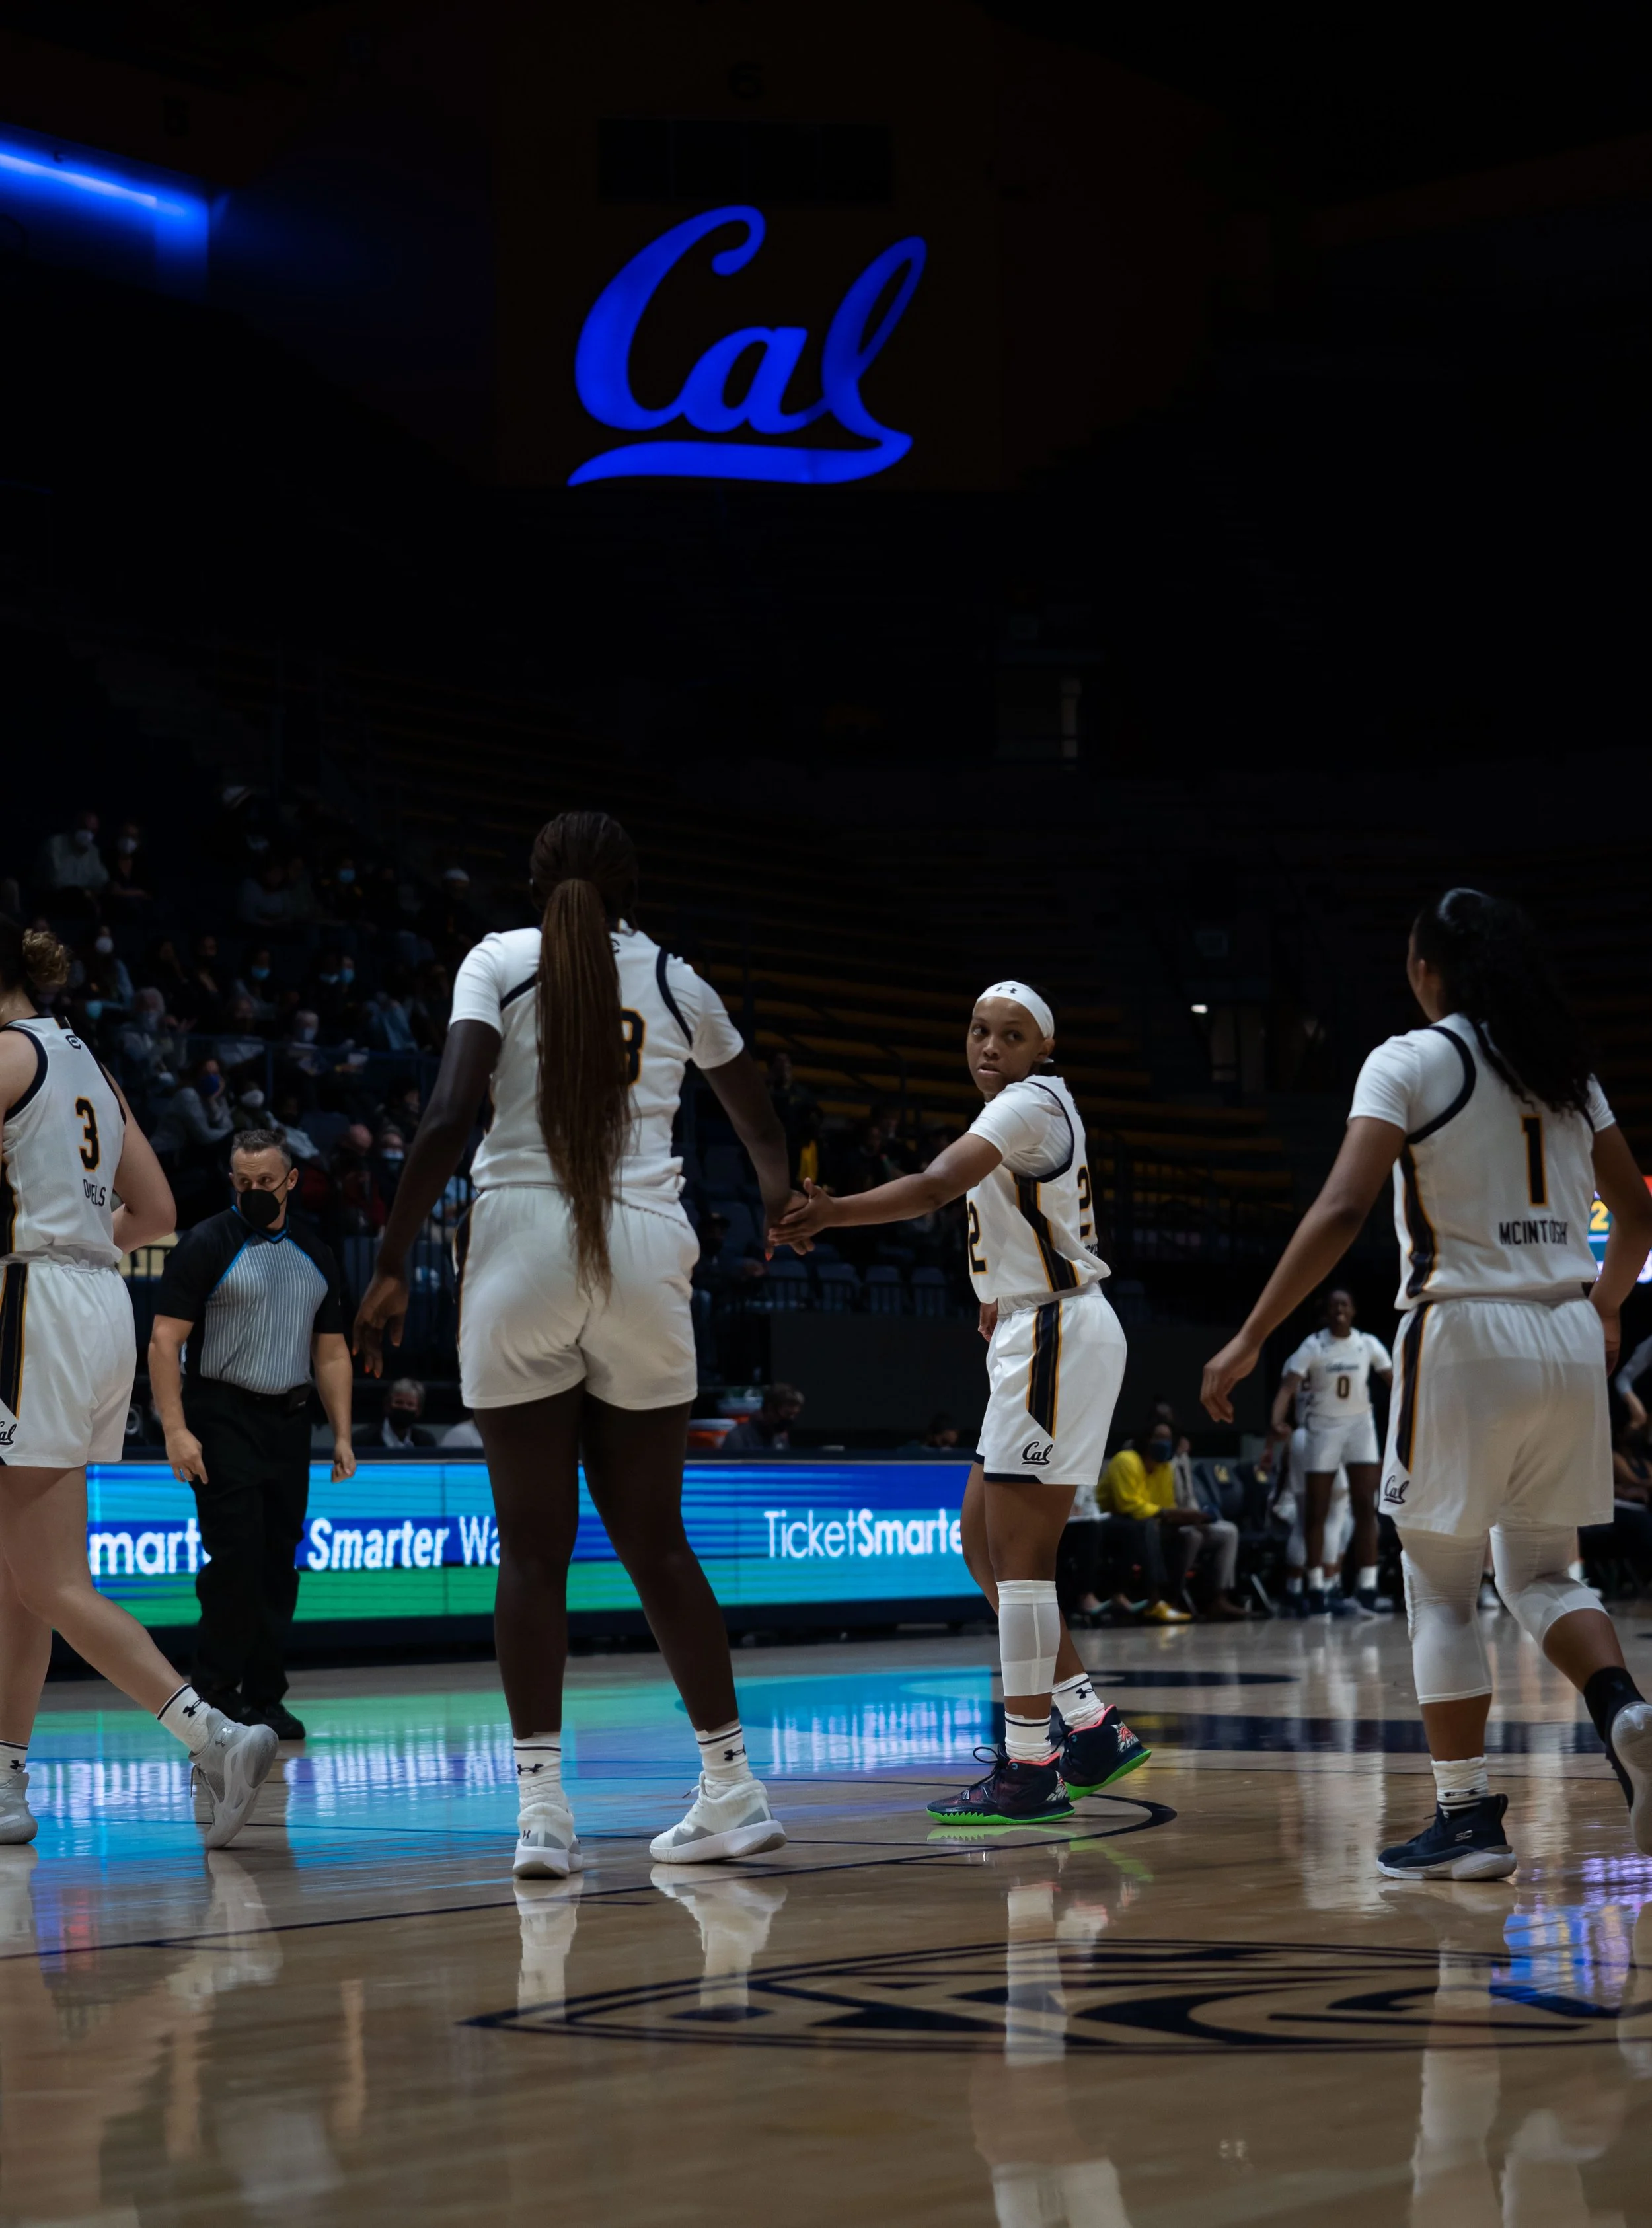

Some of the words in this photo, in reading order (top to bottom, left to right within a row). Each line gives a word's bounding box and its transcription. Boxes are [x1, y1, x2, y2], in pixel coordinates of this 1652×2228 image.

[567, 204, 927, 488] Cal
[75, 1097, 100, 1172] 3
[1521, 1113, 1548, 1207] 1
[1499, 1220, 1567, 1245] MCINTOSH
[1337, 1375, 1349, 1399] 0
[1021, 1441, 1053, 1465] Cal
[1384, 1475, 1409, 1504] Cal
[306, 1517, 450, 1571] Smarter
